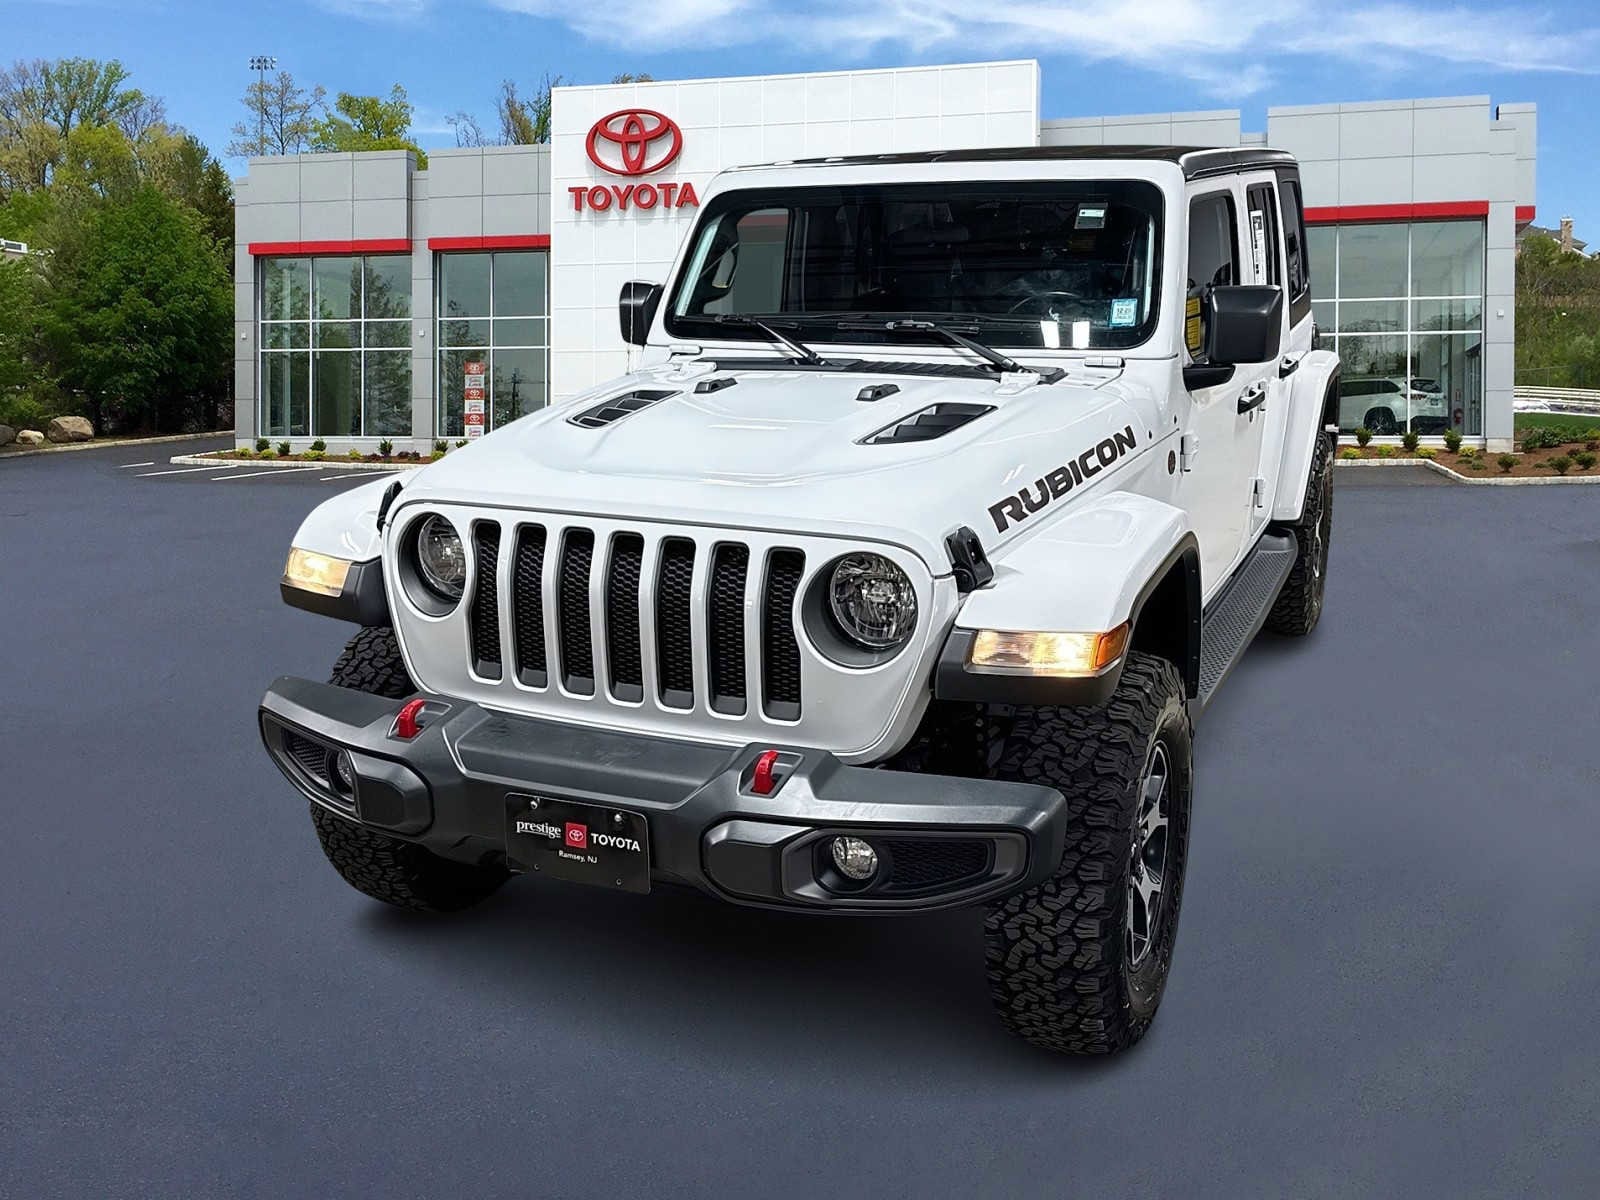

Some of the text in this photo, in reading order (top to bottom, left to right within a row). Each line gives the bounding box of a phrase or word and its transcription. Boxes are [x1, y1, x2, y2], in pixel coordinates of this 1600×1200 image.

[568, 182, 700, 212] TOYOTA
[987, 425, 1137, 534] RUBICON
[516, 821, 641, 852] prestige TOYOTA
[558, 850, 598, 864] Ramsey, NJ
